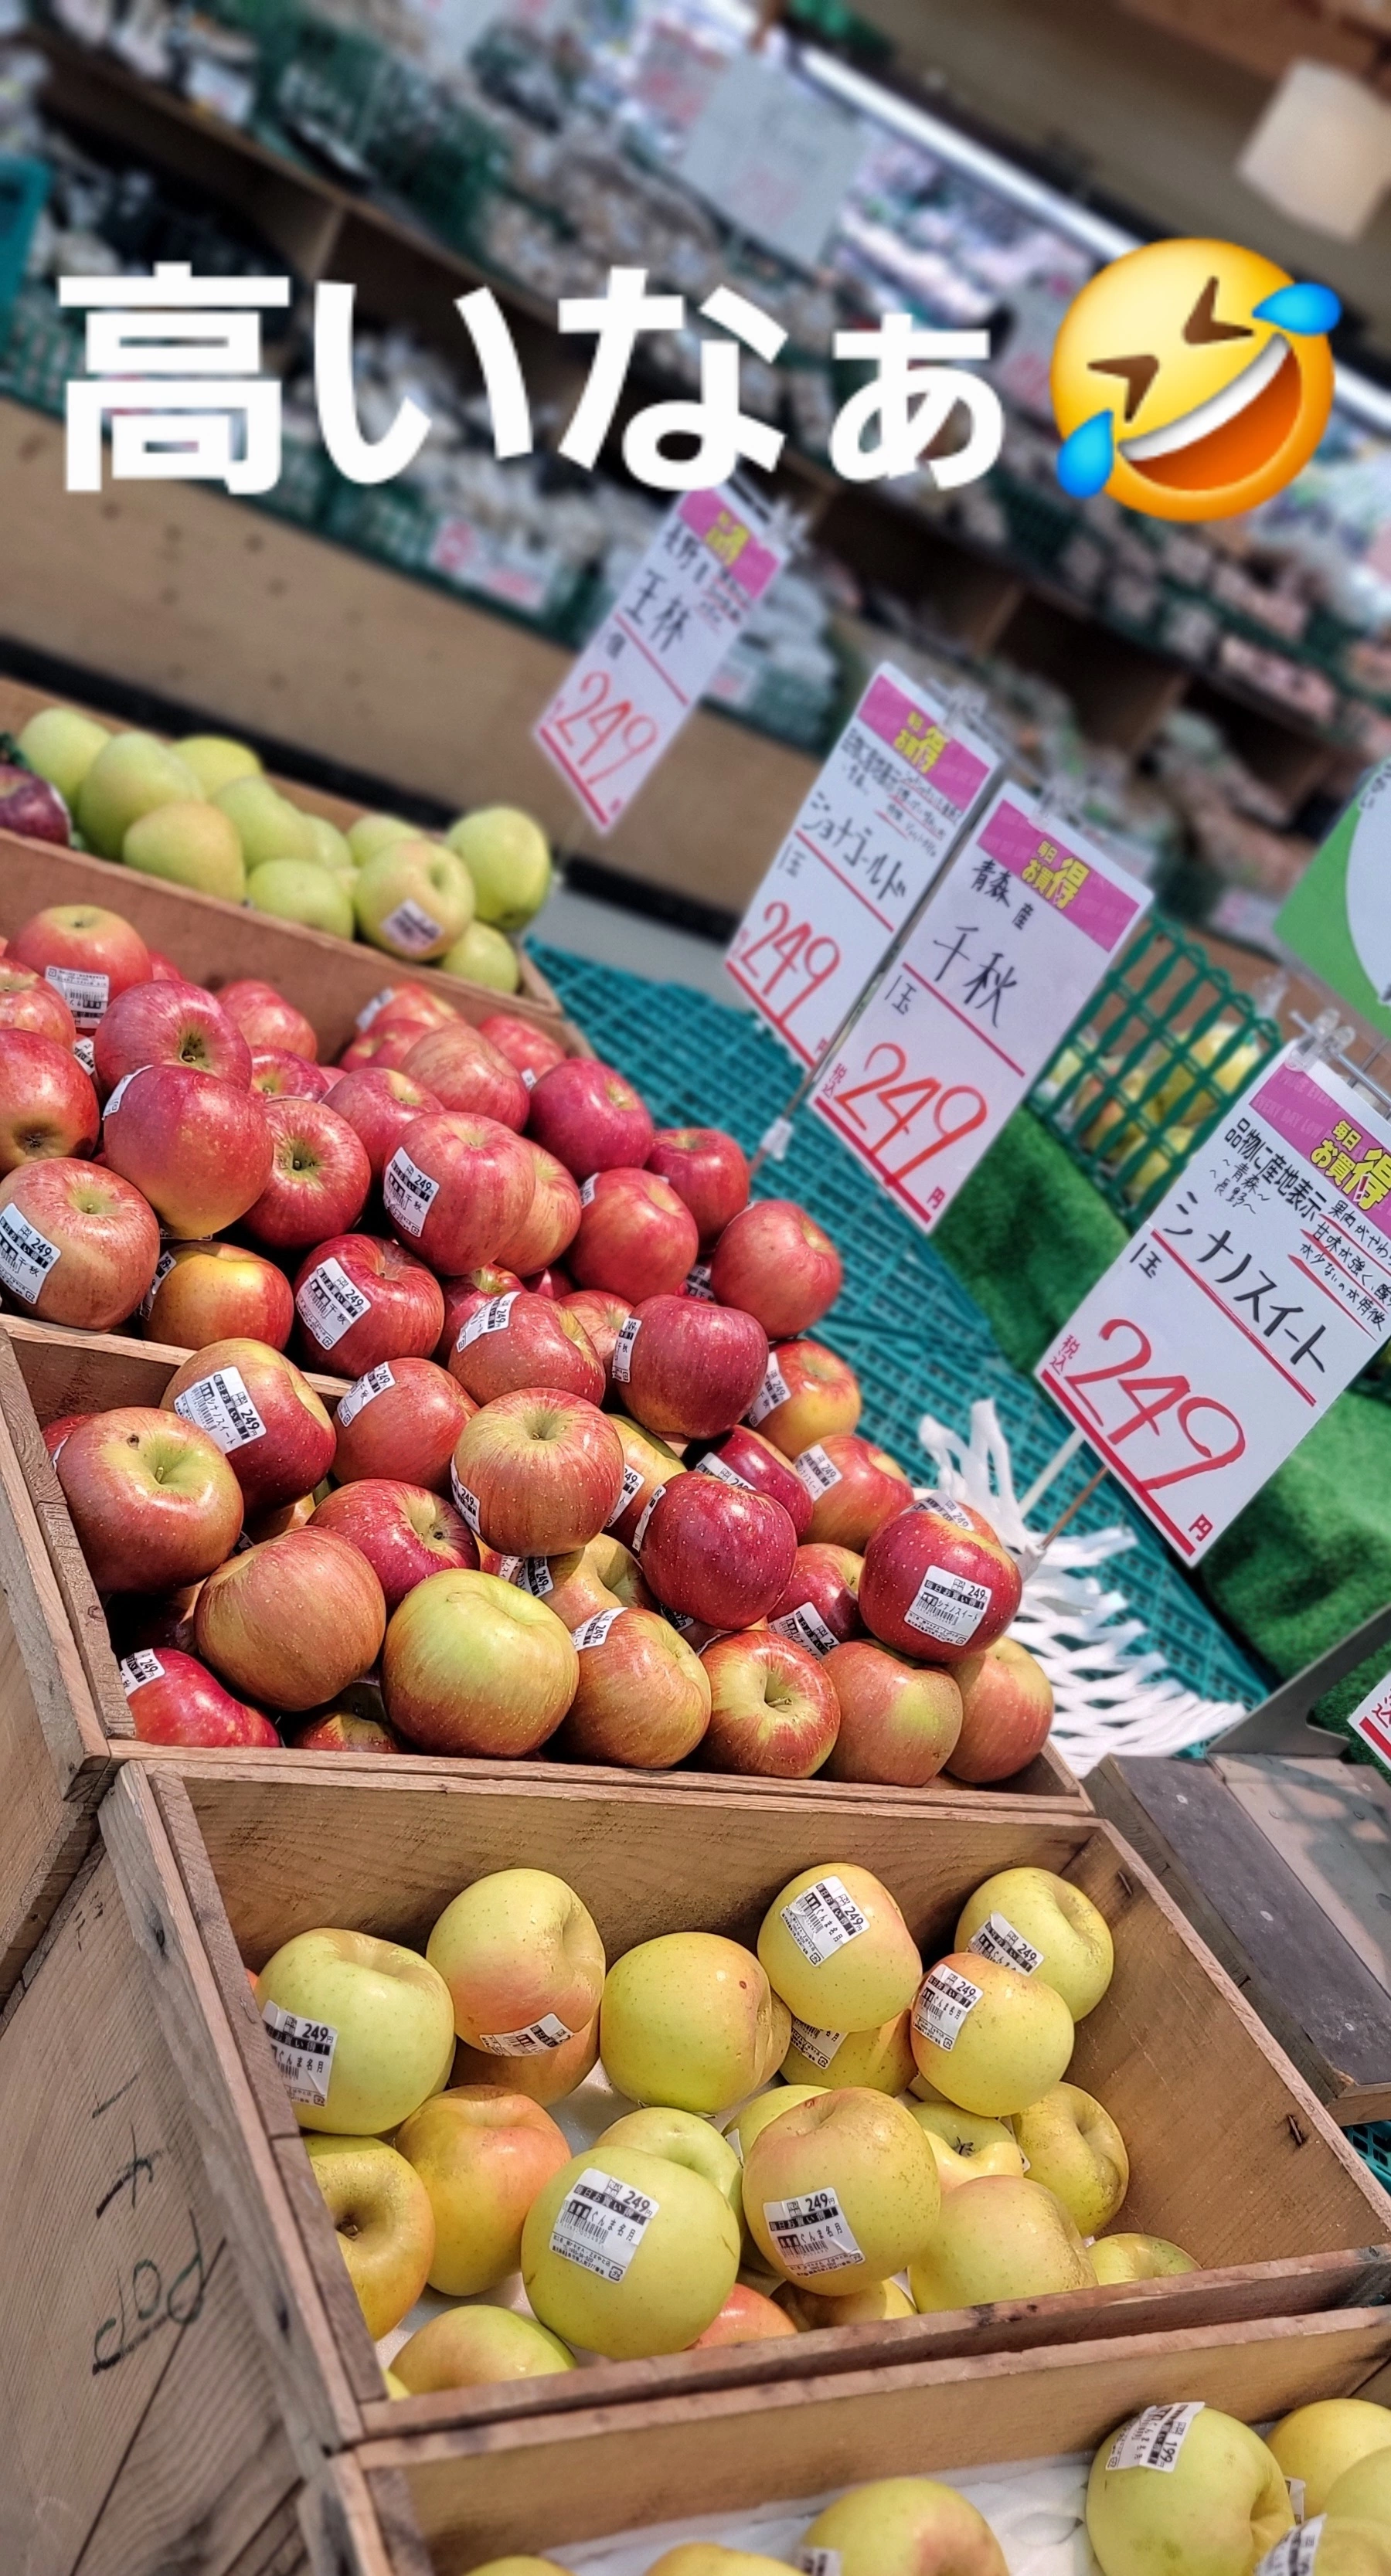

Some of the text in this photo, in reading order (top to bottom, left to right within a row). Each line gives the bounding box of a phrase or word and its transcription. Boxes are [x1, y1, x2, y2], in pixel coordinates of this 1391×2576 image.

[555, 671, 658, 785] 249
[741, 902, 840, 1022] 249
[933, 925, 1018, 1028] 千秋
[834, 1042, 988, 1184] 249
[1332, 1120, 1362, 1151] 毎日
[928, 1187, 945, 1209] 円
[1224, 1118, 1327, 1222] 品物に産地表示
[1328, 1199, 1391, 1267] 果肉がやわ
[1163, 1191, 1325, 1373] シナノスイート
[1049, 1334, 1080, 1376] 税込
[201, 1398, 240, 1446] シナノスイート
[1064, 1319, 1246, 1493] 249
[1189, 1514, 1213, 1542] 円
[936, 1600, 978, 1622] シナノスイート
[589, 2210, 636, 2241] ぐんま名月
[799, 2222, 843, 2243] ぐんま名月
